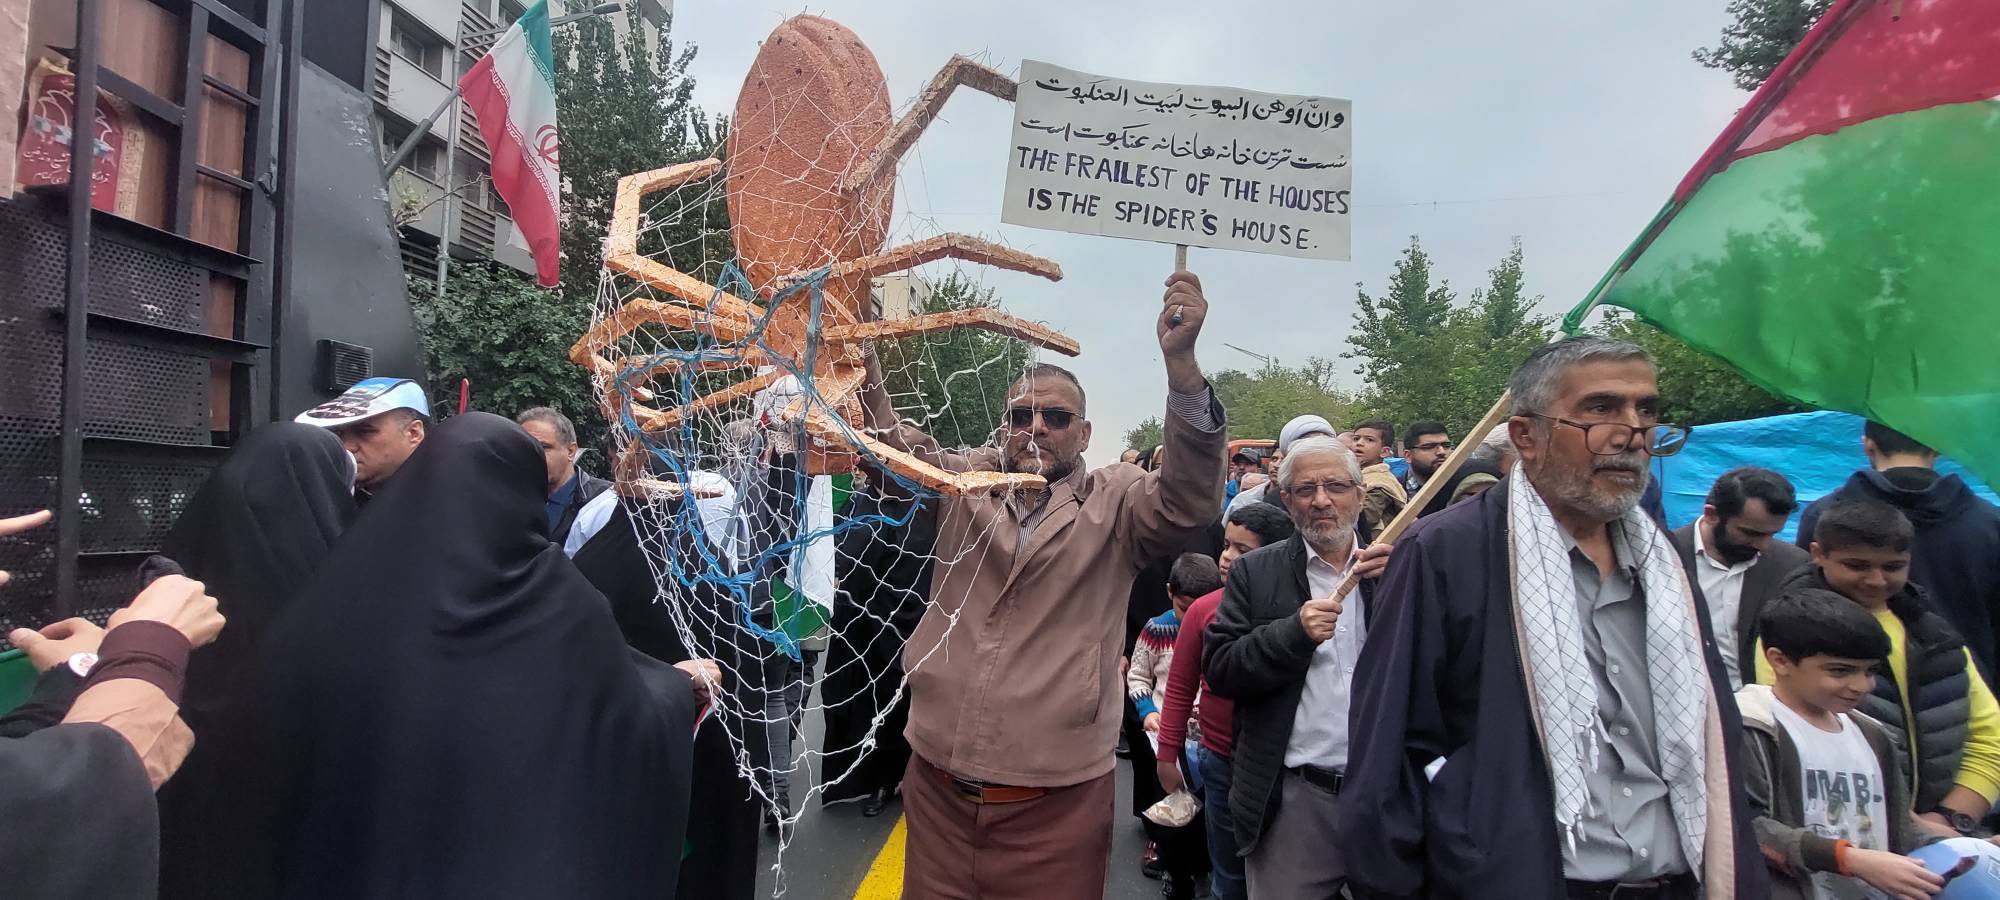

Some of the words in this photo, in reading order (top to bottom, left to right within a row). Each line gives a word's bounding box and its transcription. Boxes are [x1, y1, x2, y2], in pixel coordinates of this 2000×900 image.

[1016, 145, 1060, 173] THE
[1064, 151, 1178, 190] FRAILEST
[1185, 171, 1211, 197] OF
[1219, 176, 1262, 204] THE
[1268, 184, 1351, 215] HOUSES
[1027, 187, 1053, 211] IS
[1056, 190, 1101, 218] THE
[1114, 200, 1219, 236] SPIDER'S
[1231, 217, 1318, 250] HOUSE.
